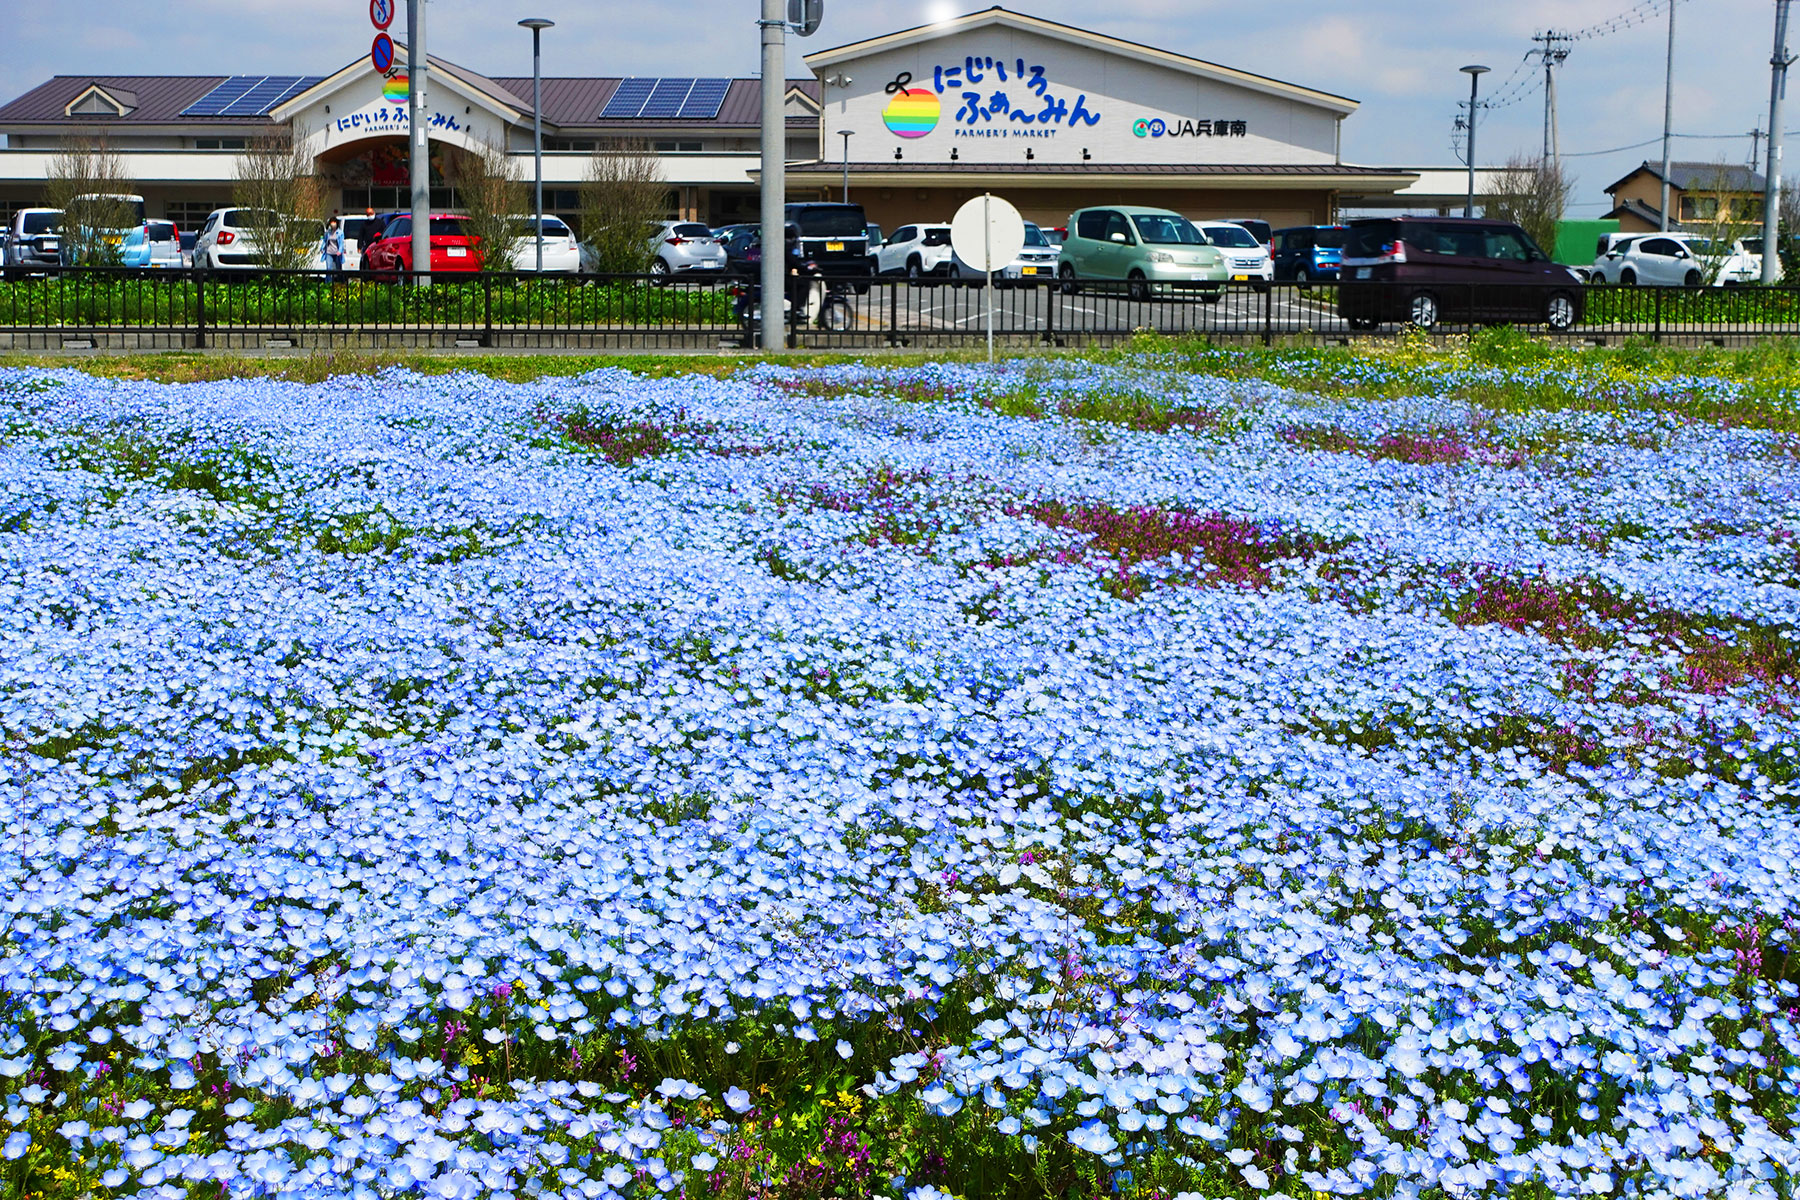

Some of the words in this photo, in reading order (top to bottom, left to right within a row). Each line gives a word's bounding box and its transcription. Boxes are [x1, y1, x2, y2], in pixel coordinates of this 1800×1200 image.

[934, 56, 1048, 96] にじいろ
[955, 129, 1008, 138] FARMER'S
[1013, 129, 1057, 138] MARKET
[1167, 119, 1247, 137] JA兵庫南
